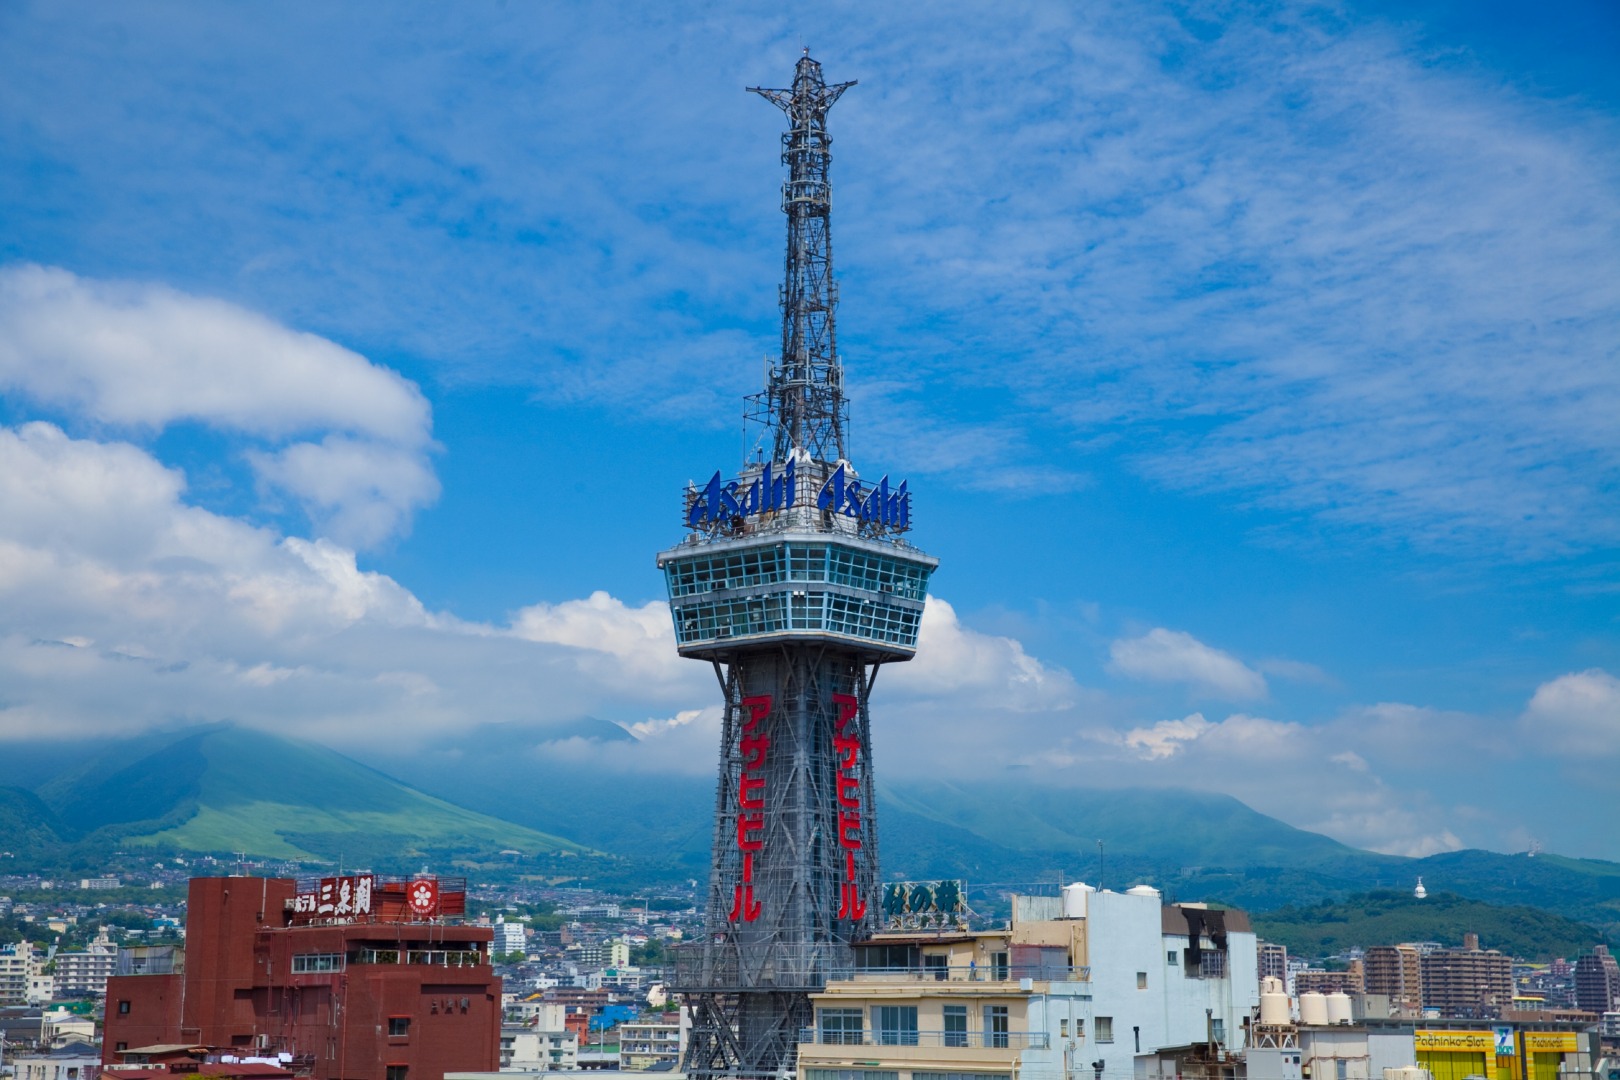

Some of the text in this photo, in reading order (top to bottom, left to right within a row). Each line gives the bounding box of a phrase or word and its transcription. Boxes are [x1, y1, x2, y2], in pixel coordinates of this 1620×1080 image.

[690, 456, 795, 526] Asahi
[817, 463, 909, 529] Asahi
[728, 694, 772, 922] アサヒビール
[832, 693, 867, 921] アサヒビール
[294, 895, 316, 912] ホテル
